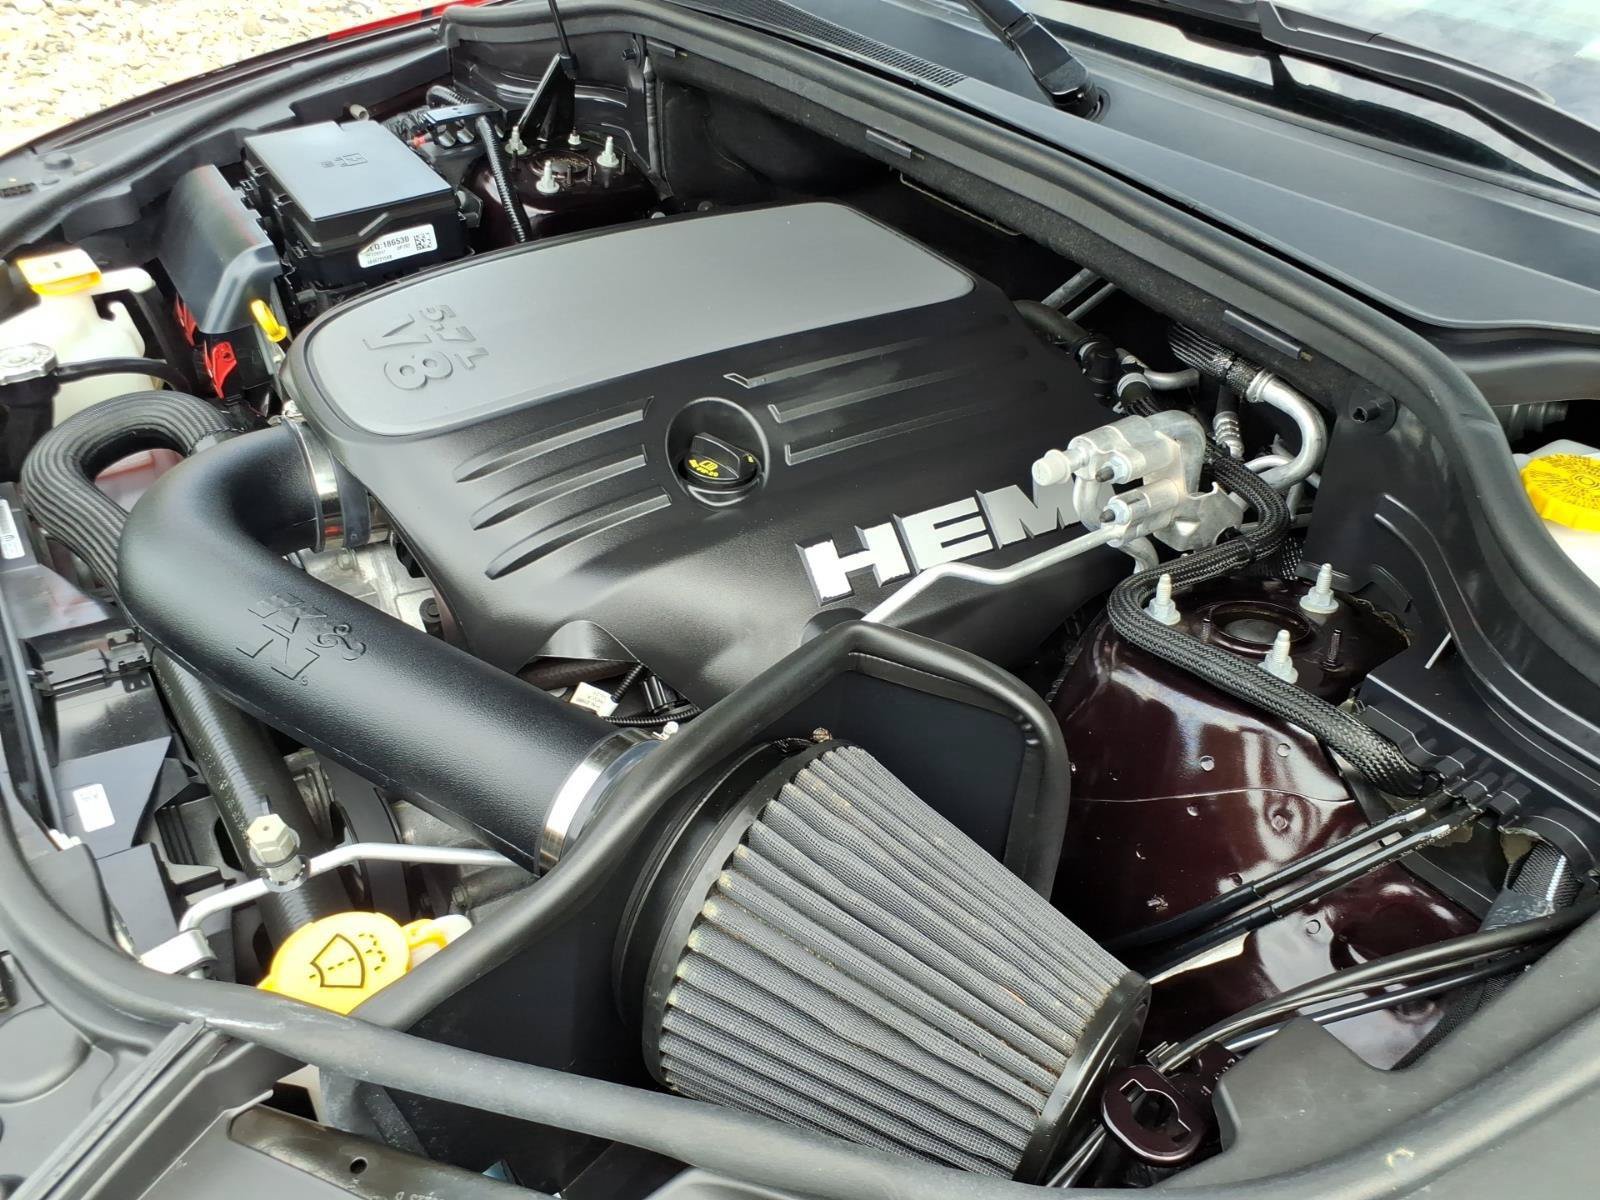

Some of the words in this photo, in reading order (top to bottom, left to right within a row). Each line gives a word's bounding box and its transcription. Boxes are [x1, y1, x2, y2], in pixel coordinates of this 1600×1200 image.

[362, 313, 454, 390] V8
[419, 304, 490, 370] 5.7L
[795, 475, 1115, 607] HEM
